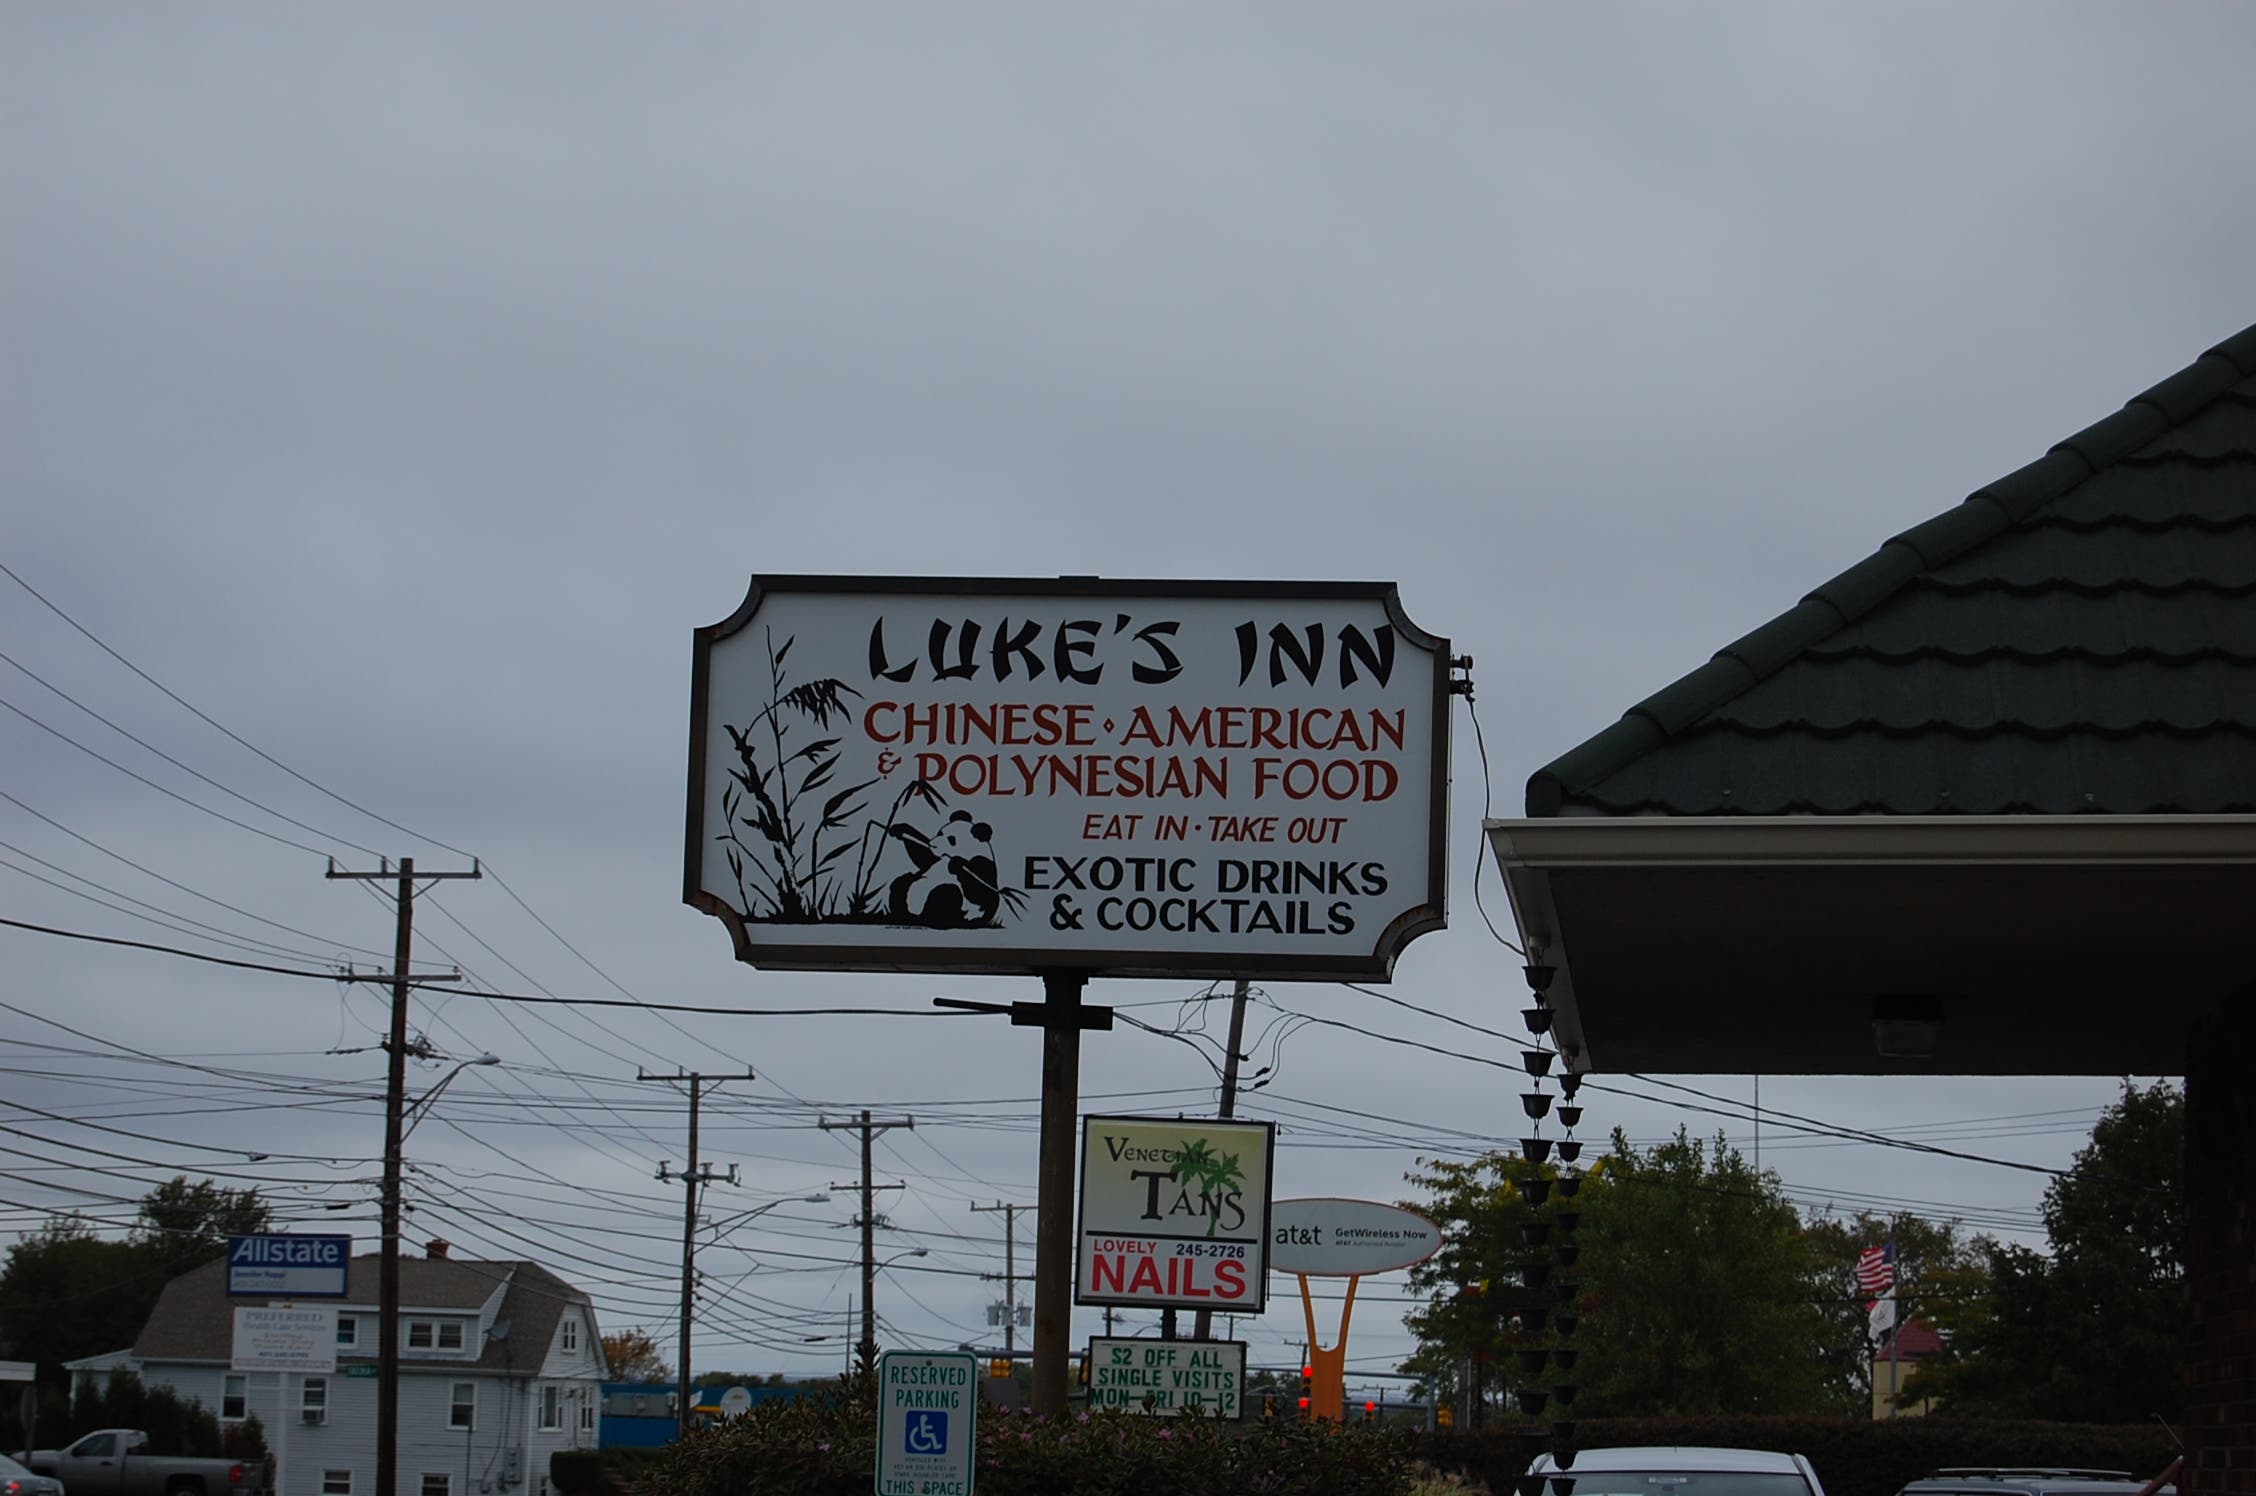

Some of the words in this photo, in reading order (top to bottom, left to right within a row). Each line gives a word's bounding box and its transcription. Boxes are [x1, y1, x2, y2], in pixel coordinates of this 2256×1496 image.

[868, 613, 1184, 686] LUKE'S
[1234, 619, 1396, 690] INN
[863, 701, 1097, 746] CHINESE
[1118, 705, 1405, 752] AMERICAN
[877, 746, 902, 779] &
[916, 753, 1228, 801] POLYNESIAN
[1251, 757, 1399, 803] FOOD
[1082, 813, 1144, 841] EAT
[1154, 815, 1189, 842] IN
[1208, 815, 1276, 843] TAKE
[1287, 816, 1349, 845] OUT
[1024, 855, 1197, 893] EXOTIC
[1217, 859, 1389, 897] DRINKS
[1049, 895, 1085, 931] &
[1096, 896, 1356, 936] COCKTAILS
[1130, 1169, 1246, 1231] TANS
[1275, 1225, 1323, 1246] at&t
[1403, 1229, 1428, 1240] Now
[232, 1238, 339, 1263] Allstate
[1093, 1239, 1157, 1254] LOVELY
[1176, 1243, 1245, 1259] 245-2726
[1091, 1254, 1246, 1299] NAILS
[1144, 1349, 1176, 1367] OFF
[1190, 1351, 1223, 1369] ALL
[890, 1366, 967, 1386] RESERVED
[1098, 1368, 1162, 1387] SINGLE
[1173, 1370, 1234, 1390] VISITS
[895, 1389, 960, 1409] PARKING
[1091, 1387, 1174, 1408] MON-RI
[886, 1480, 914, 1495] THIS
[922, 1480, 964, 1496] SPACE
